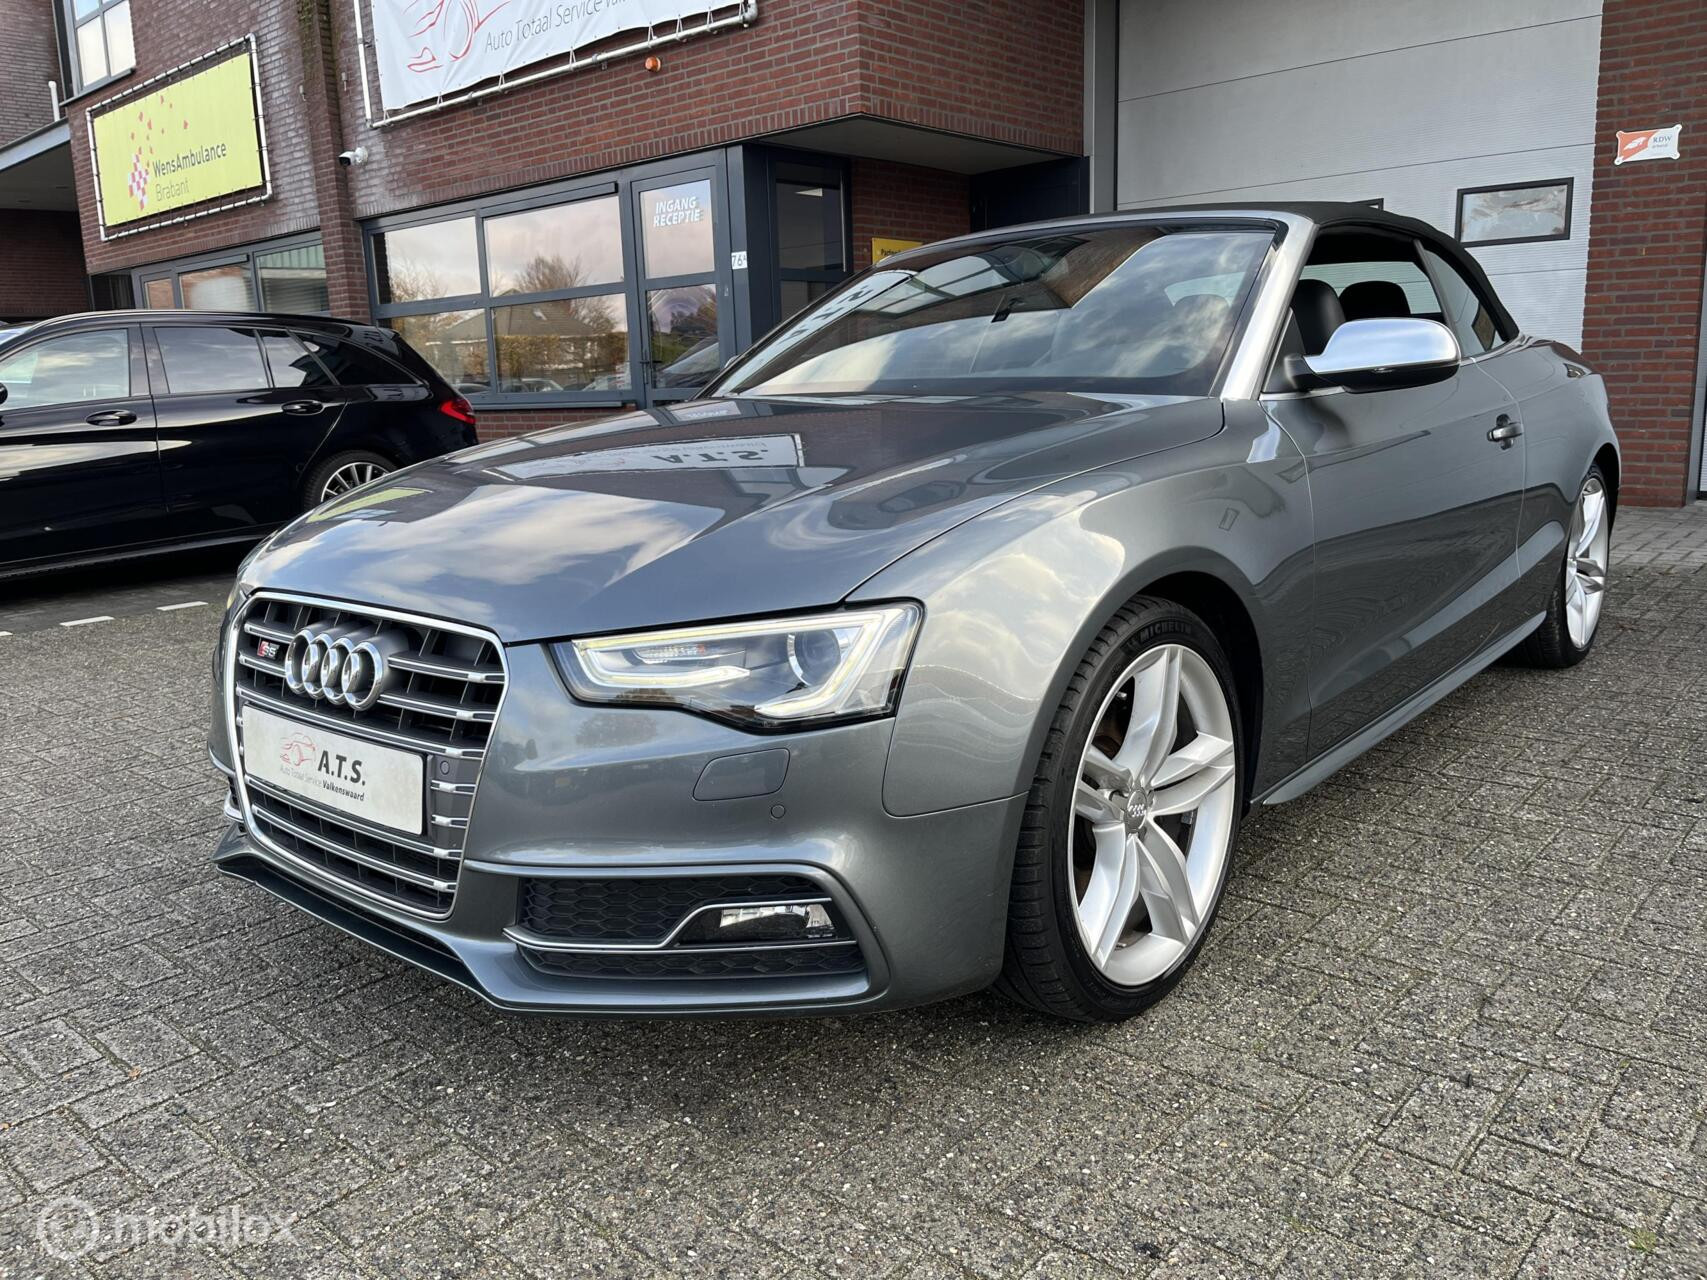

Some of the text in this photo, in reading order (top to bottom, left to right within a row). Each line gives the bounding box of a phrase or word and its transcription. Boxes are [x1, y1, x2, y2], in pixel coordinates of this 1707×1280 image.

[485, 0, 601, 53] Auto Totaal Service
[152, 142, 227, 178] WensAmbulance
[155, 178, 190, 201] Brabant
[655, 196, 697, 214] INGANG
[653, 208, 701, 228] RECEPTIE
[1140, 621, 1192, 640] MICHELIN
[317, 749, 366, 786] A.T.S.
[322, 779, 365, 801] Valkenswaard
